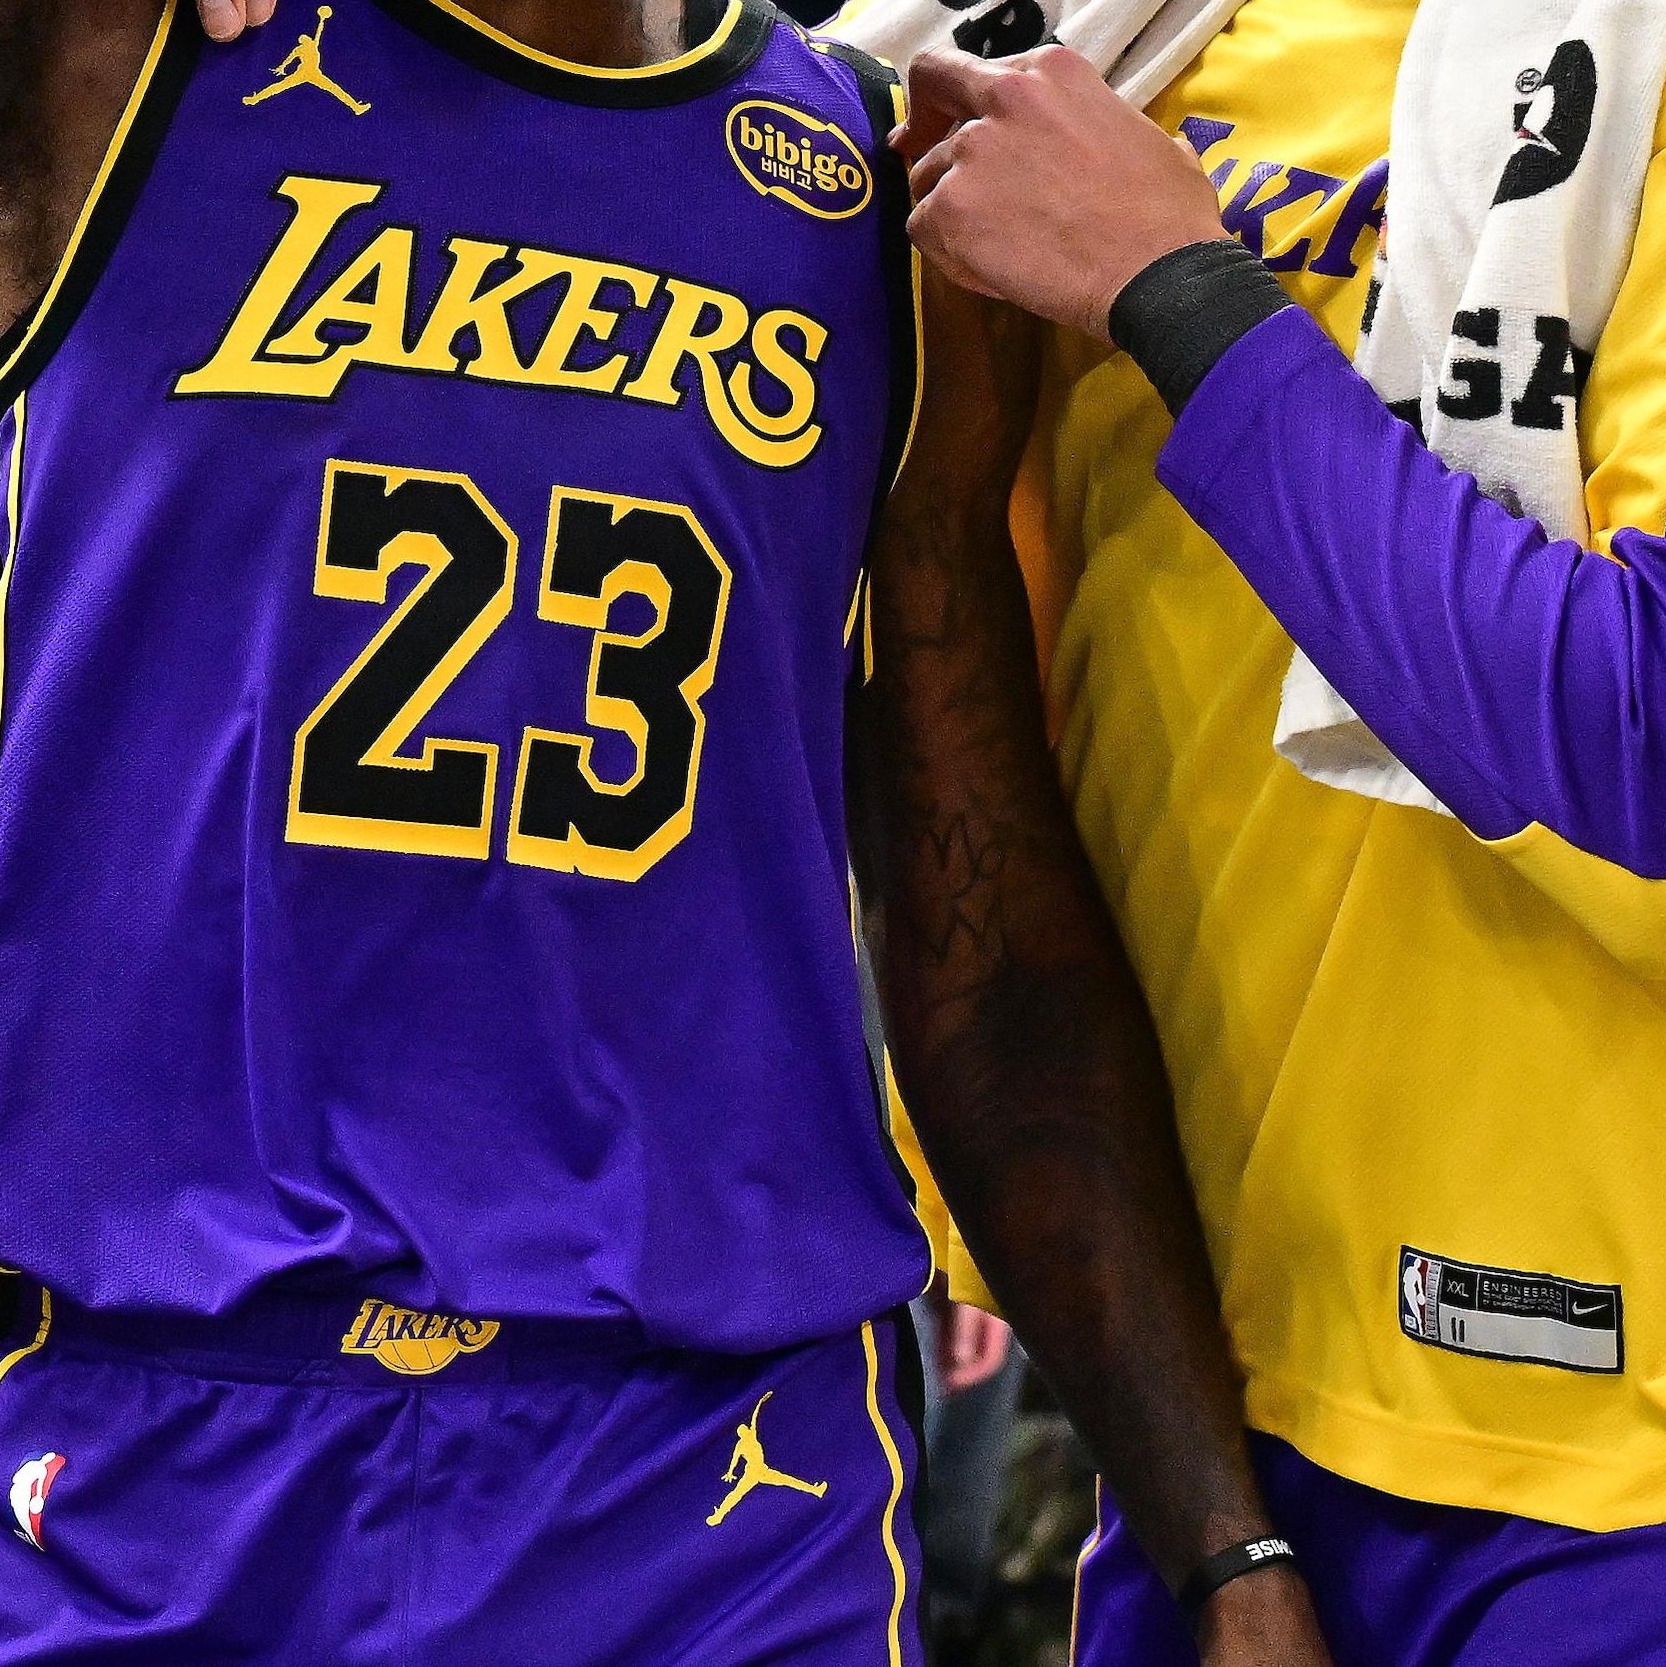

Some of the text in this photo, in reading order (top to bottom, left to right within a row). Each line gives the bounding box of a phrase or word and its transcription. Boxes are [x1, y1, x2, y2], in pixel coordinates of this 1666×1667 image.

[739, 116, 863, 192] bibigo
[761, 156, 813, 191] 비비고
[174, 175, 827, 468] LAKERS
[285, 459, 733, 883] 23
[1446, 1278, 1470, 1298] XXL
[1482, 1280, 1563, 1301] ENGINEERED
[1449, 1315, 1467, 1343] 11
